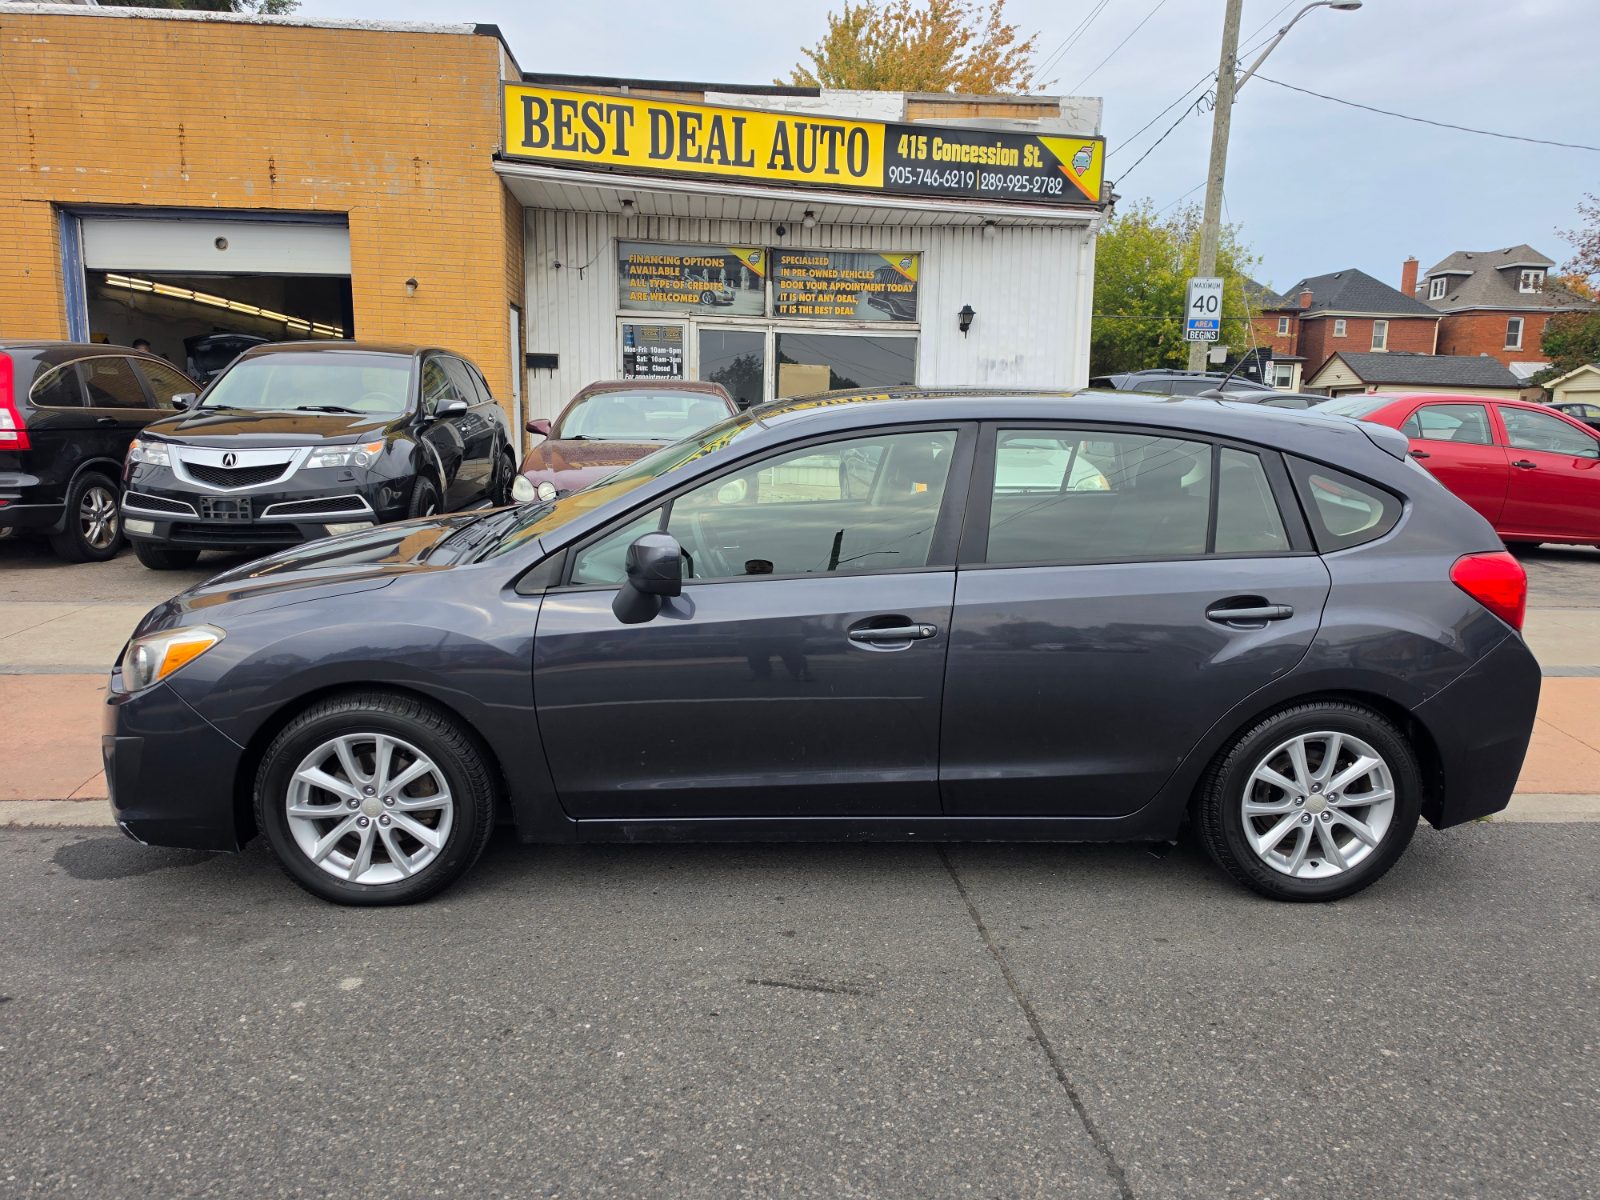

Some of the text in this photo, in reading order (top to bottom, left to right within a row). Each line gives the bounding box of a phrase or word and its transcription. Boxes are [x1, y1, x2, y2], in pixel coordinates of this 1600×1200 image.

[520, 95, 870, 178] BEST DEAL AUTO
[897, 134, 1044, 168] 415 Concession St.
[888, 165, 1063, 195] 905-746-6219 289-925-2782
[629, 254, 725, 268] FINANCING OPTIONS
[781, 256, 830, 266] SPECIALIZED
[629, 265, 680, 276] AVAILABLE
[781, 268, 875, 279] IN PRE-OWNED VEHICLES
[630, 278, 724, 292] ALL TYPE OF CREDITS
[780, 280, 914, 293] BOOK YOUR APPOINTMENT TODAY
[1194, 282, 1221, 290] MAXIMUM
[629, 291, 699, 303] ARE WELCOMED
[780, 293, 788, 301] IT
[789, 293, 797, 301] IS
[799, 293, 816, 302] NOT
[817, 294, 835, 303] ANY
[780, 305, 855, 315] IT IS THE BEST DEAL
[1192, 295, 1218, 313] 40
[1190, 330, 1216, 340] BEGINS
